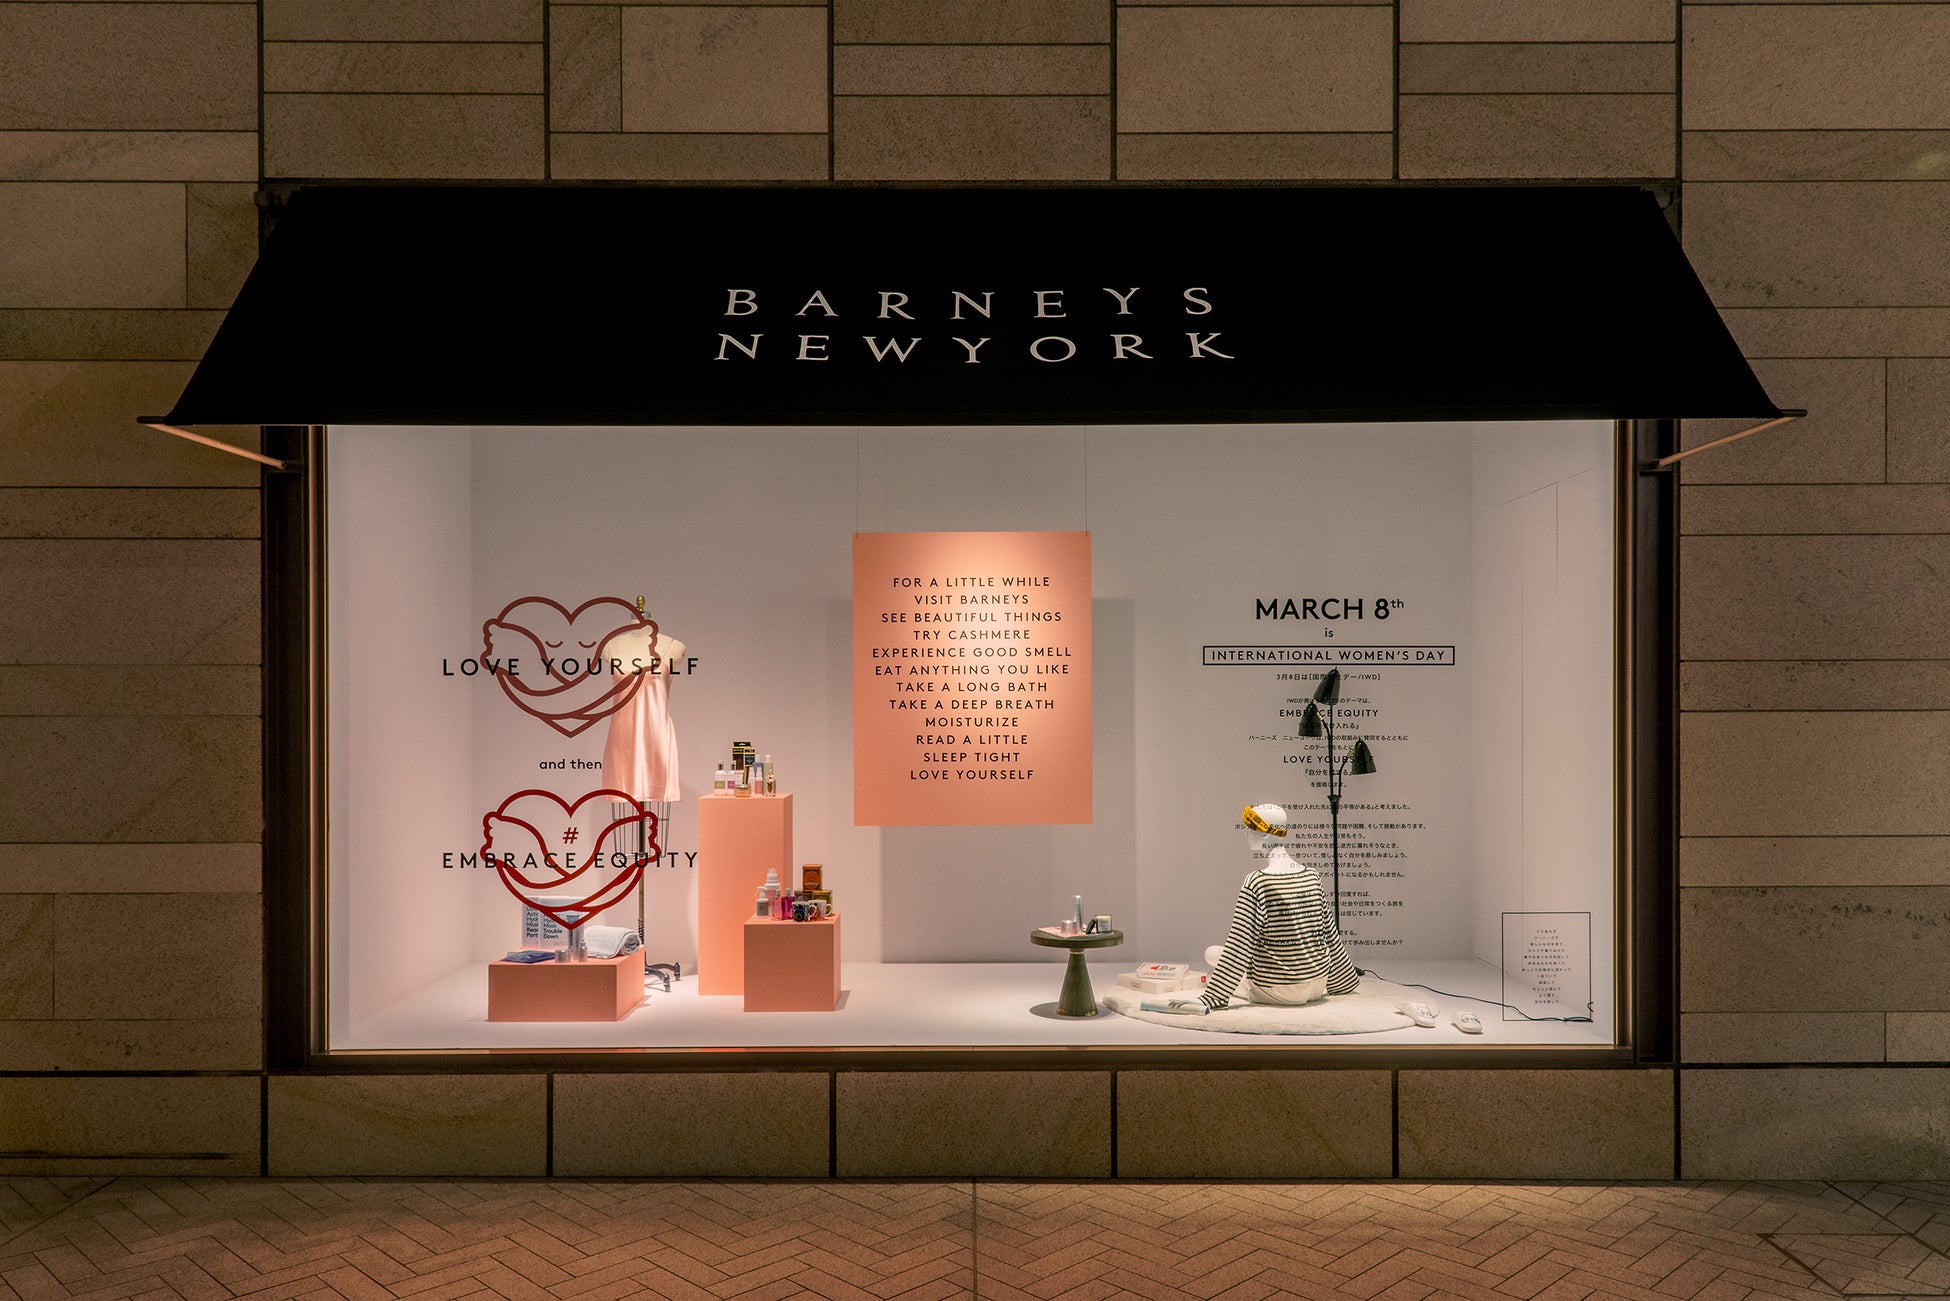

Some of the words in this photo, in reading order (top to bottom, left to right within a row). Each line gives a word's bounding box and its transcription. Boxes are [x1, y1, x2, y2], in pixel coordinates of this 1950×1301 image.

[723, 287, 1212, 320] BARNEYS
[893, 577, 922, 588] FOR
[929, 577, 939, 588] A
[946, 577, 994, 588] LITTLE
[1001, 576, 1050, 587] WHILE
[914, 594, 953, 605] VISIT
[960, 594, 1029, 605] BARNEYS
[1255, 597, 1363, 620] MARCH
[881, 612, 907, 623] SEE
[914, 612, 997, 623] BEAUTIFUL
[1004, 611, 1062, 622] THINGS
[913, 630, 941, 641] TRY
[948, 629, 1030, 640] CASHMERE
[1324, 627, 1334, 638] is
[872, 647, 965, 658] EXPERIENCE
[973, 647, 1018, 658] GOOD
[1025, 646, 1072, 657] SMELL
[1212, 650, 1333, 661] INTERNATIONAL
[1338, 650, 1410, 661] WOMEN'S
[1415, 650, 1446, 661] DAY
[442, 657, 520, 676] LOVE
[541, 657, 699, 676] YOURSELF
[875, 665, 902, 676] EAT
[909, 664, 990, 676] ANYTHING
[997, 664, 1029, 675] YOU
[1036, 664, 1069, 675] LIKE
[896, 682, 934, 692] TAKE
[941, 682, 951, 692] A
[958, 681, 1000, 692] LONG
[1008, 682, 1047, 692] BATH
[889, 699, 927, 710] TAKE
[934, 700, 944, 710] A
[951, 699, 988, 710] DEEP
[995, 699, 1054, 710] BREATH
[1279, 709, 1333, 718] EMBRCE
[1337, 709, 1379, 718] EQUITY
[925, 717, 1019, 728] MOISTURIZE
[916, 734, 956, 745] READ
[962, 735, 972, 745] A
[979, 734, 1028, 745] LITTLE
[923, 752, 968, 763] SLEEP
[974, 752, 1020, 763] TIGHT
[1283, 755, 1312, 764] LOVE
[1316, 755, 1375, 764] YOURSF
[539, 758, 566, 770] and
[569, 758, 602, 770] then
[910, 769, 949, 780] LOVE
[956, 769, 1034, 780] YOURSELF
[442, 851, 577, 869] EMBRACE
[594, 851, 699, 869] EQUITY
